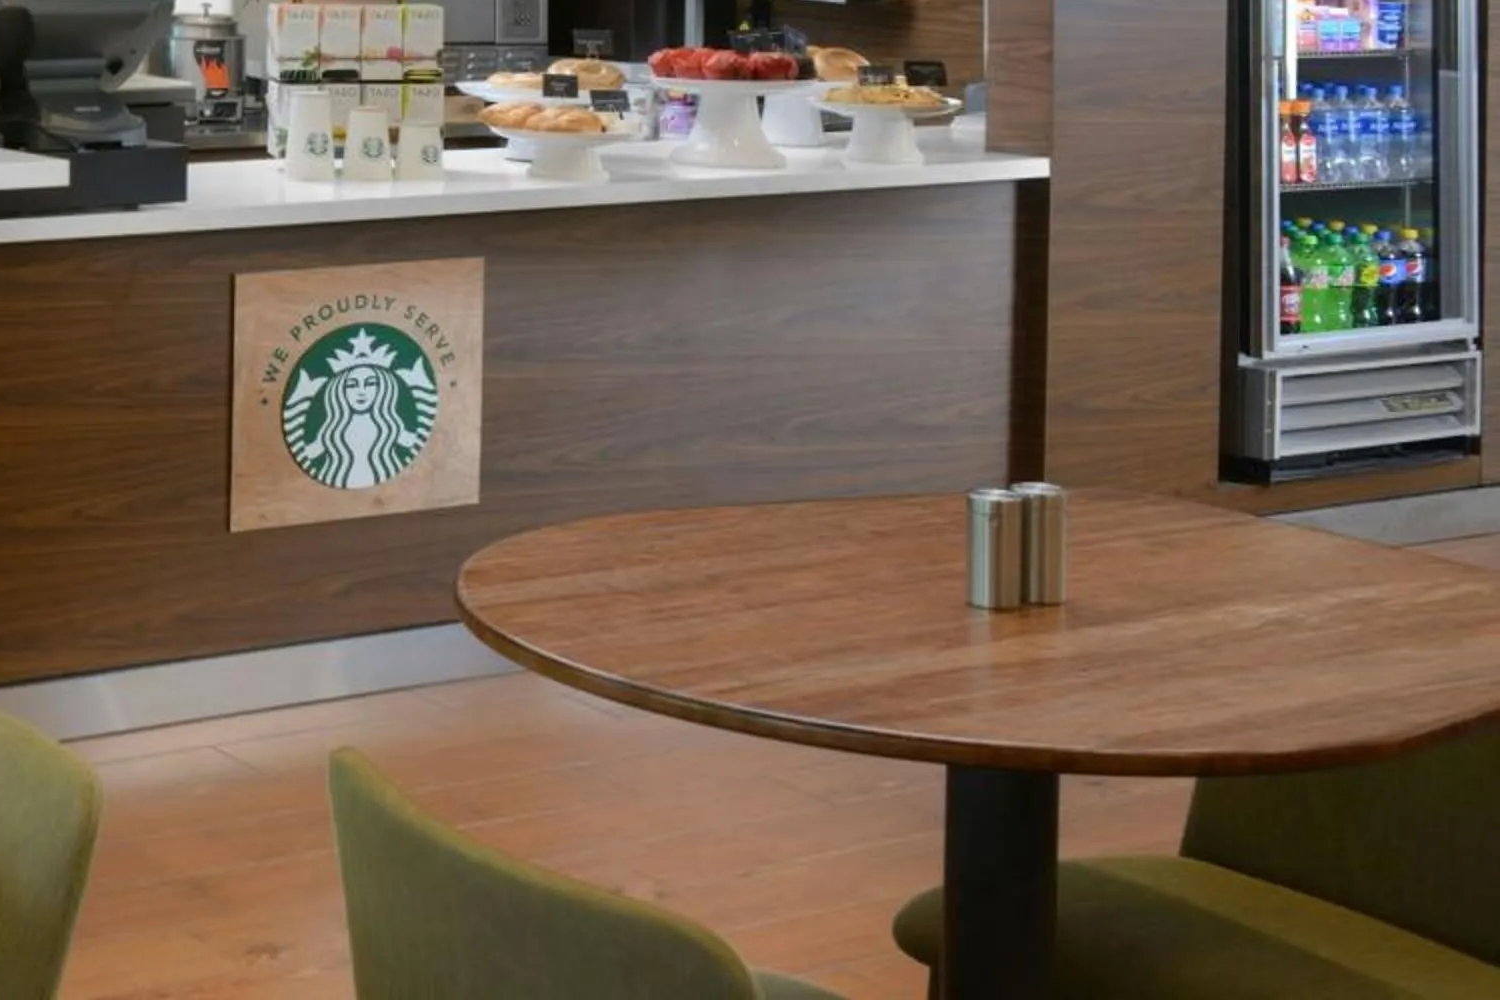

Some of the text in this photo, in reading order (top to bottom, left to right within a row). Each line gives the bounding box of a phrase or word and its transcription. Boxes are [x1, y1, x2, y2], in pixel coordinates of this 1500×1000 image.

[262, 294, 456, 385] WE PROUDLY SERVE
